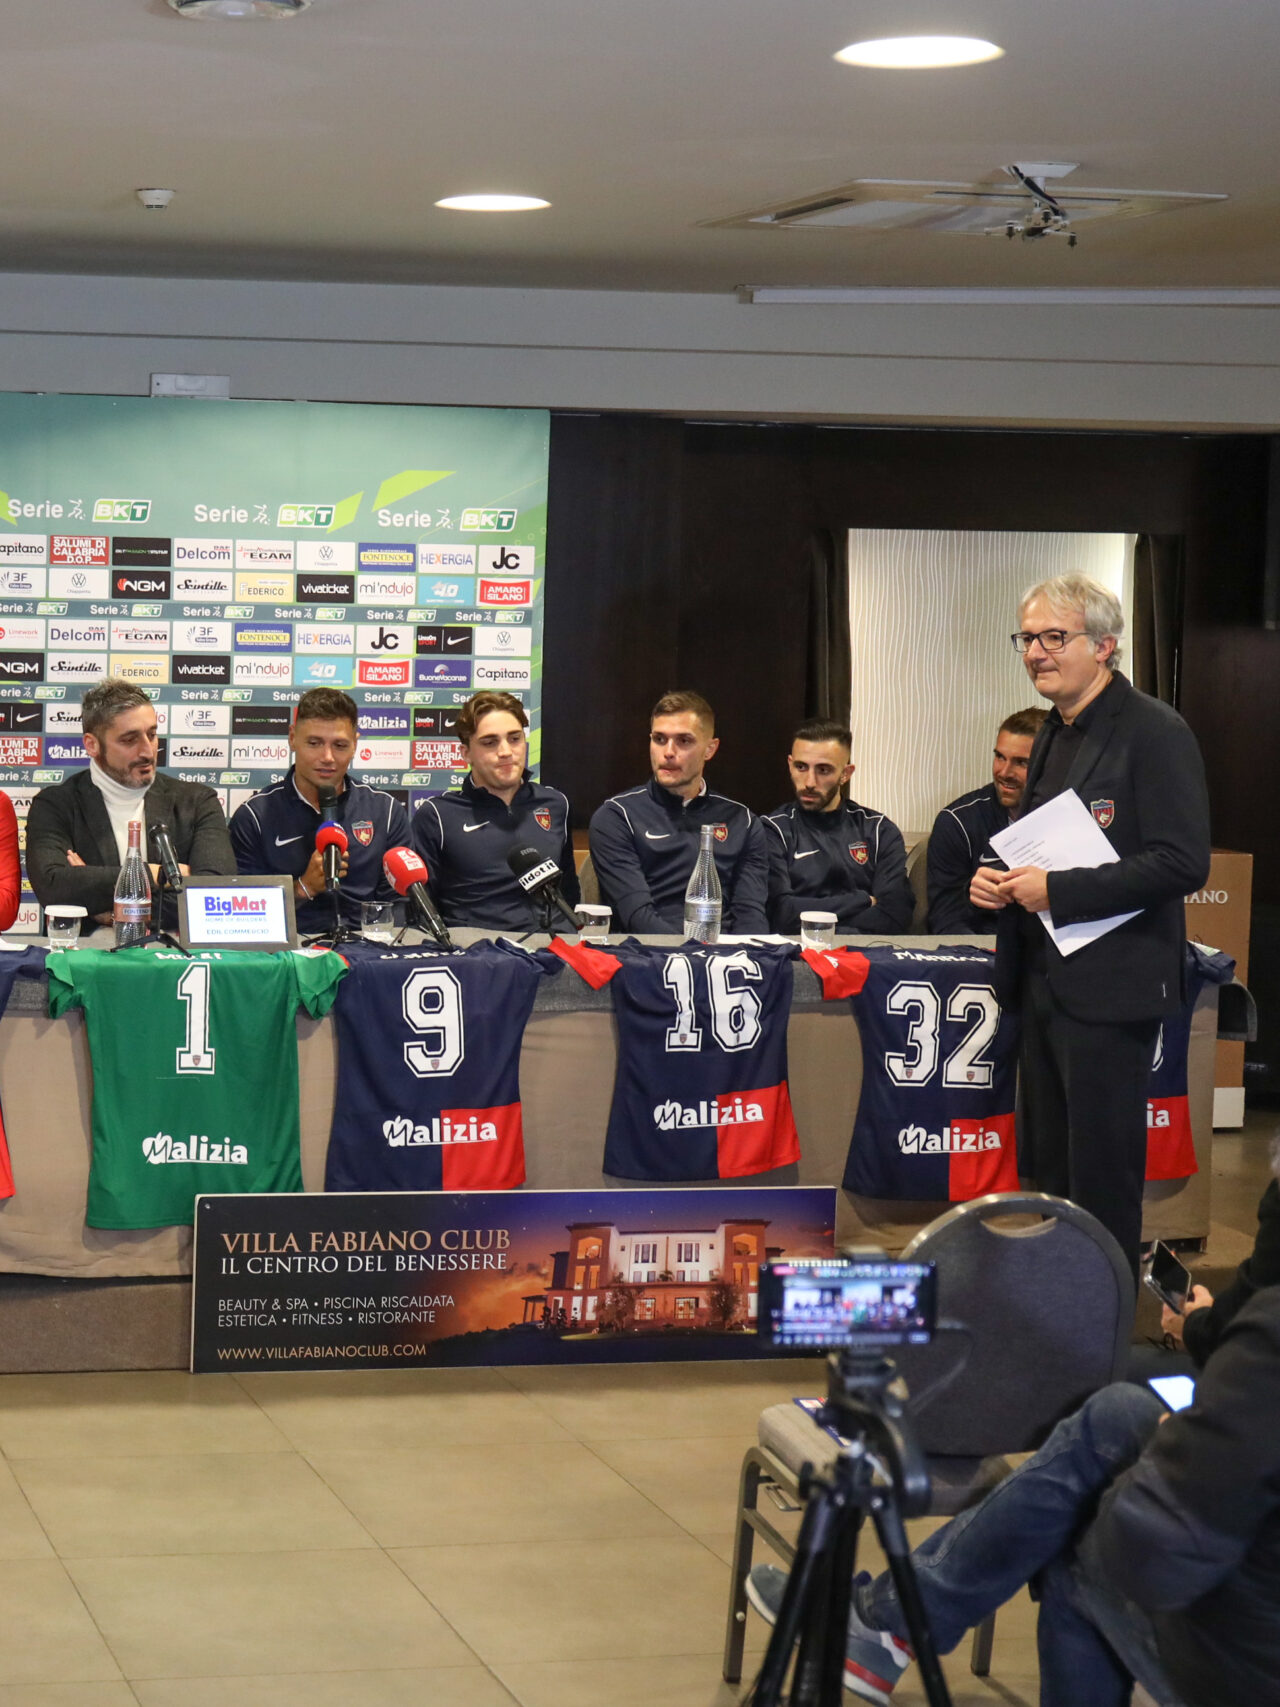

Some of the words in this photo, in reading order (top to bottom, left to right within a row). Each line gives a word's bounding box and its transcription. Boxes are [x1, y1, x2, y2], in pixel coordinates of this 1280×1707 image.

[8, 499, 63, 518] Serie
[96, 502, 148, 519] BKT
[194, 504, 248, 523] Serie
[281, 507, 332, 523] BKT
[378, 509, 431, 527] Serie
[463, 512, 514, 527] BKT
[53, 539, 91, 547] SALUMI
[96, 539, 105, 547] DI
[53, 548, 105, 556] CALABRIA
[177, 547, 230, 560] Delcom
[420, 556, 472, 565] HEXERGIA
[13, 573, 27, 581] 3F
[124, 580, 165, 592] NGM
[302, 584, 349, 594] vivaticket
[488, 586, 522, 594] AMARO
[90, 605, 118, 614] Serie
[183, 607, 210, 616] Serie
[275, 609, 301, 618] Serie
[367, 610, 394, 620] Serie
[456, 612, 482, 621] Serie
[51, 628, 105, 641] Delcom
[200, 627, 213, 635] 3F
[298, 634, 351, 645] HEXERGIA
[178, 666, 224, 675] vivaticket
[367, 666, 402, 674] AMARO
[477, 668, 528, 680] Capitano
[182, 690, 209, 700] Serie
[273, 691, 300, 701] Serie
[365, 693, 392, 702] Serie
[198, 711, 211, 719] 3F
[358, 716, 407, 729] Malizia
[28, 740, 38, 748] DI
[416, 742, 452, 752] SALUMI
[179, 773, 206, 782] Serie
[362, 775, 388, 784] Serie
[205, 896, 266, 916] BigMat
[663, 950, 762, 1052] 16
[176, 961, 216, 1074] 1
[402, 966, 465, 1078] 9
[885, 980, 1002, 1089] 32
[654, 1098, 765, 1130] Malizia
[383, 1115, 497, 1147] Malizia
[898, 1123, 1001, 1154] Malizia
[142, 1131, 248, 1164] Malizia
[221, 1233, 301, 1254] VILLA
[309, 1230, 432, 1252] FABIANO
[441, 1229, 510, 1250] CLUB
[221, 1258, 239, 1274] IL
[247, 1256, 338, 1274] CENTRO
[348, 1255, 386, 1273] DEL
[395, 1253, 507, 1272] BENESSERE
[219, 1299, 267, 1312] BEAUTY
[271, 1299, 281, 1311] &
[286, 1298, 309, 1310] SPA
[324, 1297, 376, 1310] PISCINA
[382, 1295, 455, 1309] RISCALDATA
[218, 1314, 277, 1327] ESTETICA
[292, 1313, 343, 1326] FITNESS
[359, 1311, 436, 1324] RISTORANTE
[218, 1344, 426, 1361] WWW.VILLAFABIANOCLUB.COM
